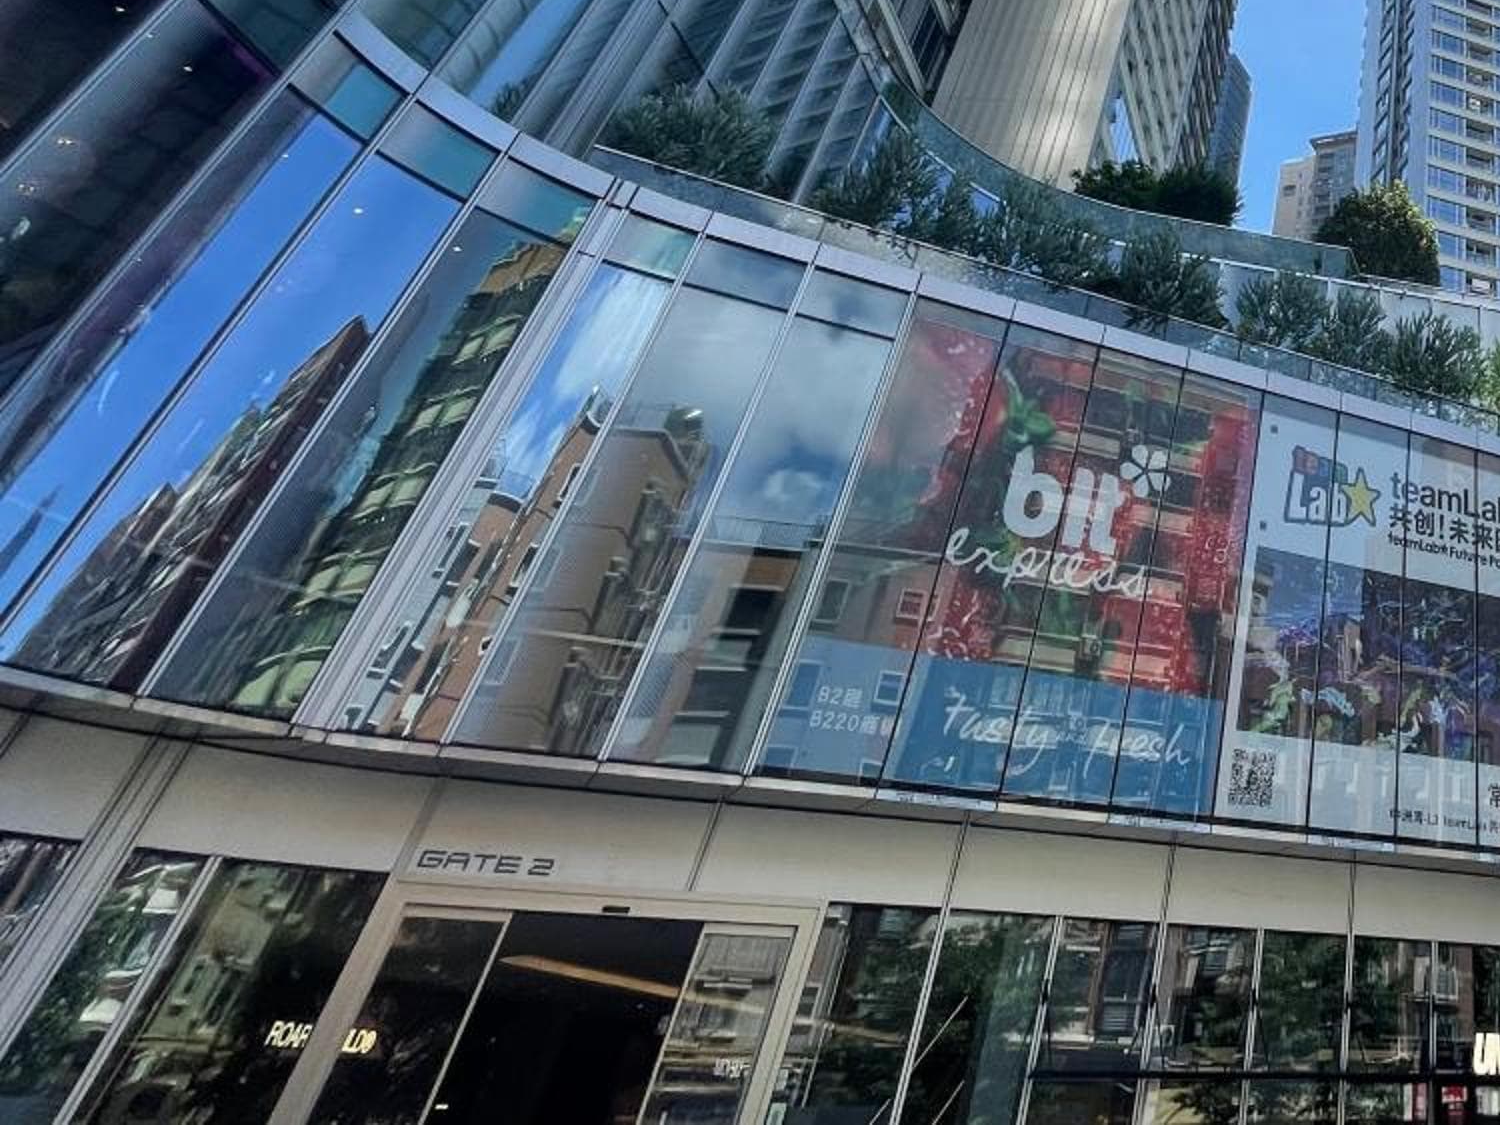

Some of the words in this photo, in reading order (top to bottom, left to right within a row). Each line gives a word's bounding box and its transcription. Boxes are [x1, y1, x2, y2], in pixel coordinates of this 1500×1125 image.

[1289, 472, 1350, 524] Lab
[417, 849, 523, 874] GATE
[528, 858, 555, 876] 2
